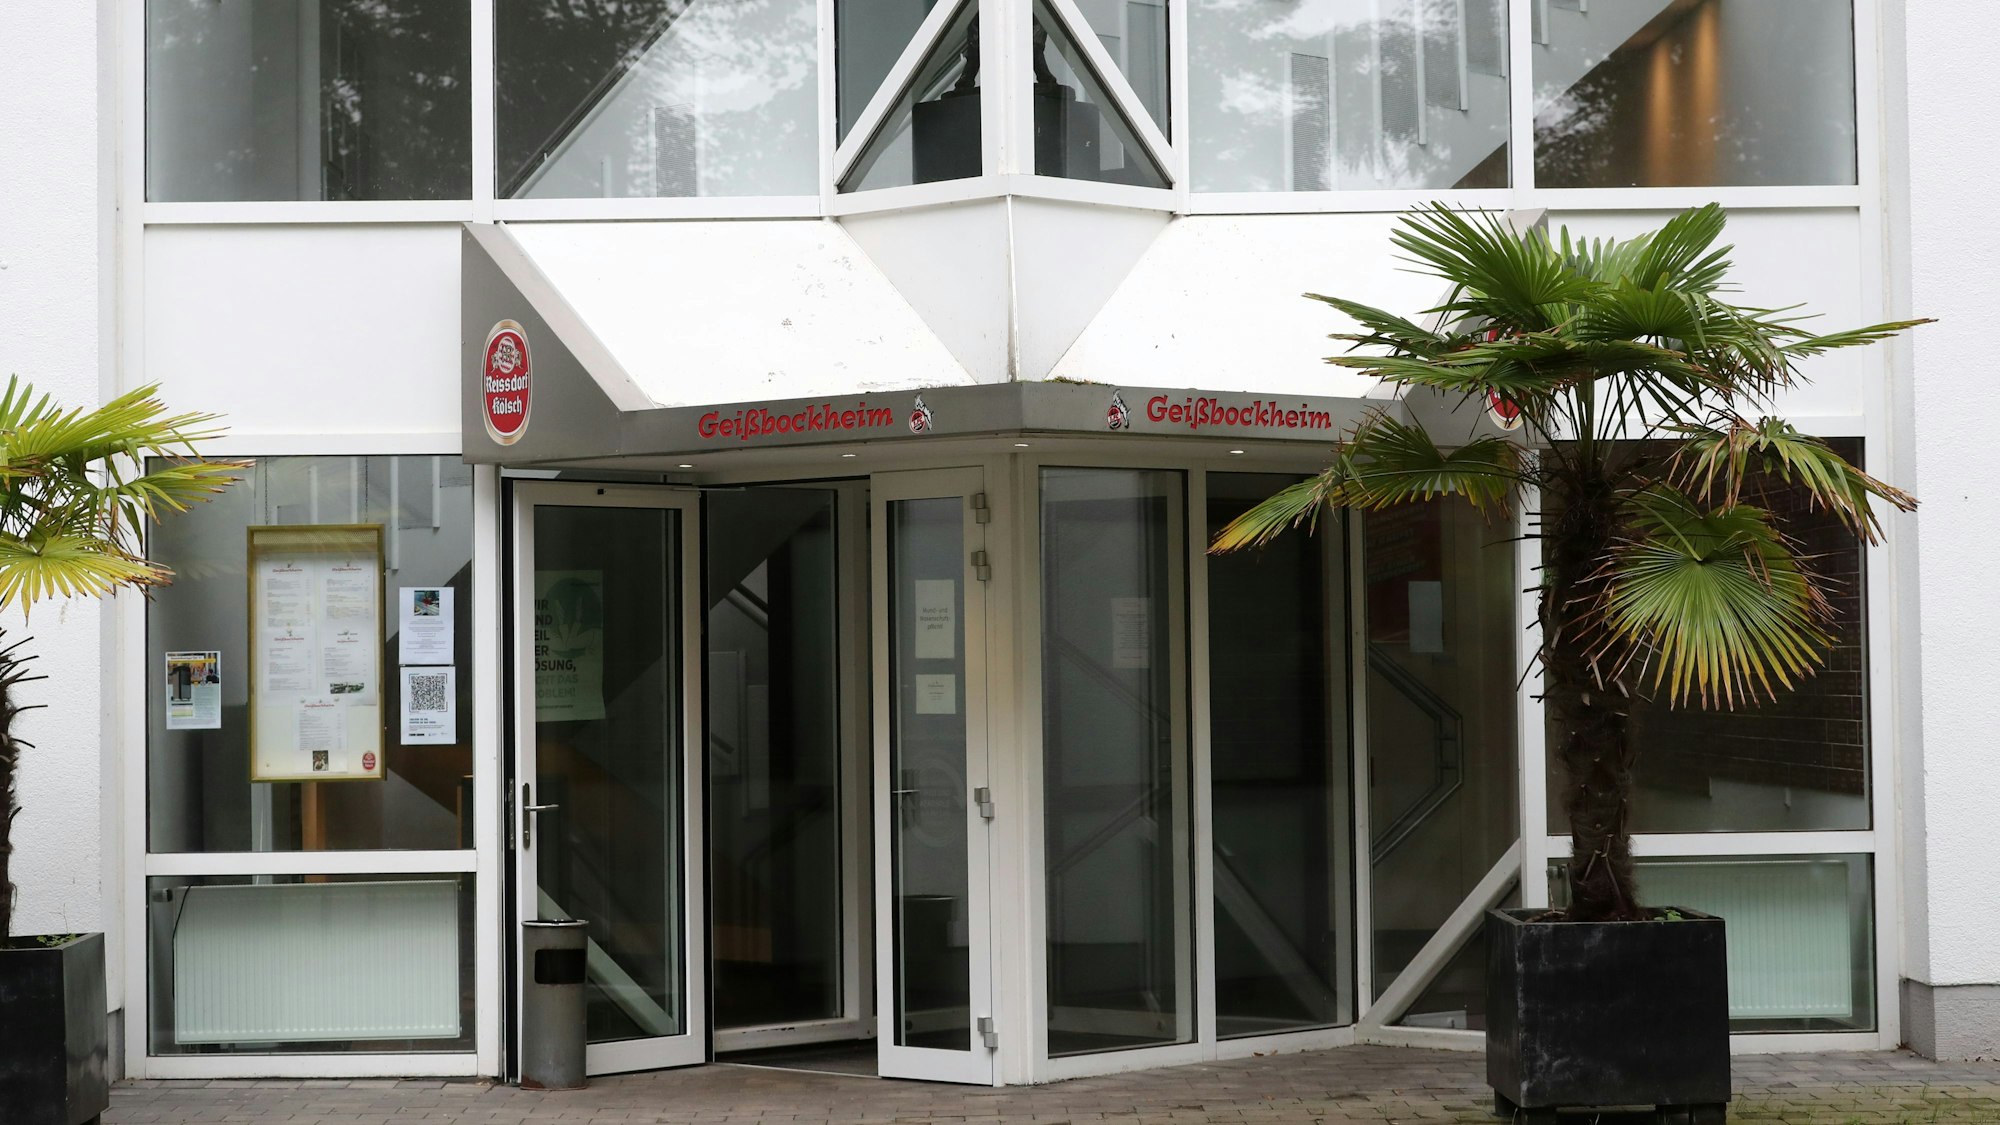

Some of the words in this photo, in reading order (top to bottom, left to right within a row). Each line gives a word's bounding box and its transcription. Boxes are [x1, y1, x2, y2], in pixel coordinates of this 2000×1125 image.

[486, 372, 528, 393] Reissdorf
[492, 395, 522, 415] Kölsch
[1146, 394, 1332, 430] Geißbockheim
[698, 401, 894, 441] Geißbockheim
[535, 599, 549, 611] IR
[535, 614, 552, 626] ND
[535, 629, 550, 641] EIL
[535, 645, 549, 656] ER
[535, 658, 577, 673] ÖSUNG,
[536, 675, 555, 686] CHT
[537, 688, 576, 699] OBLEM!
